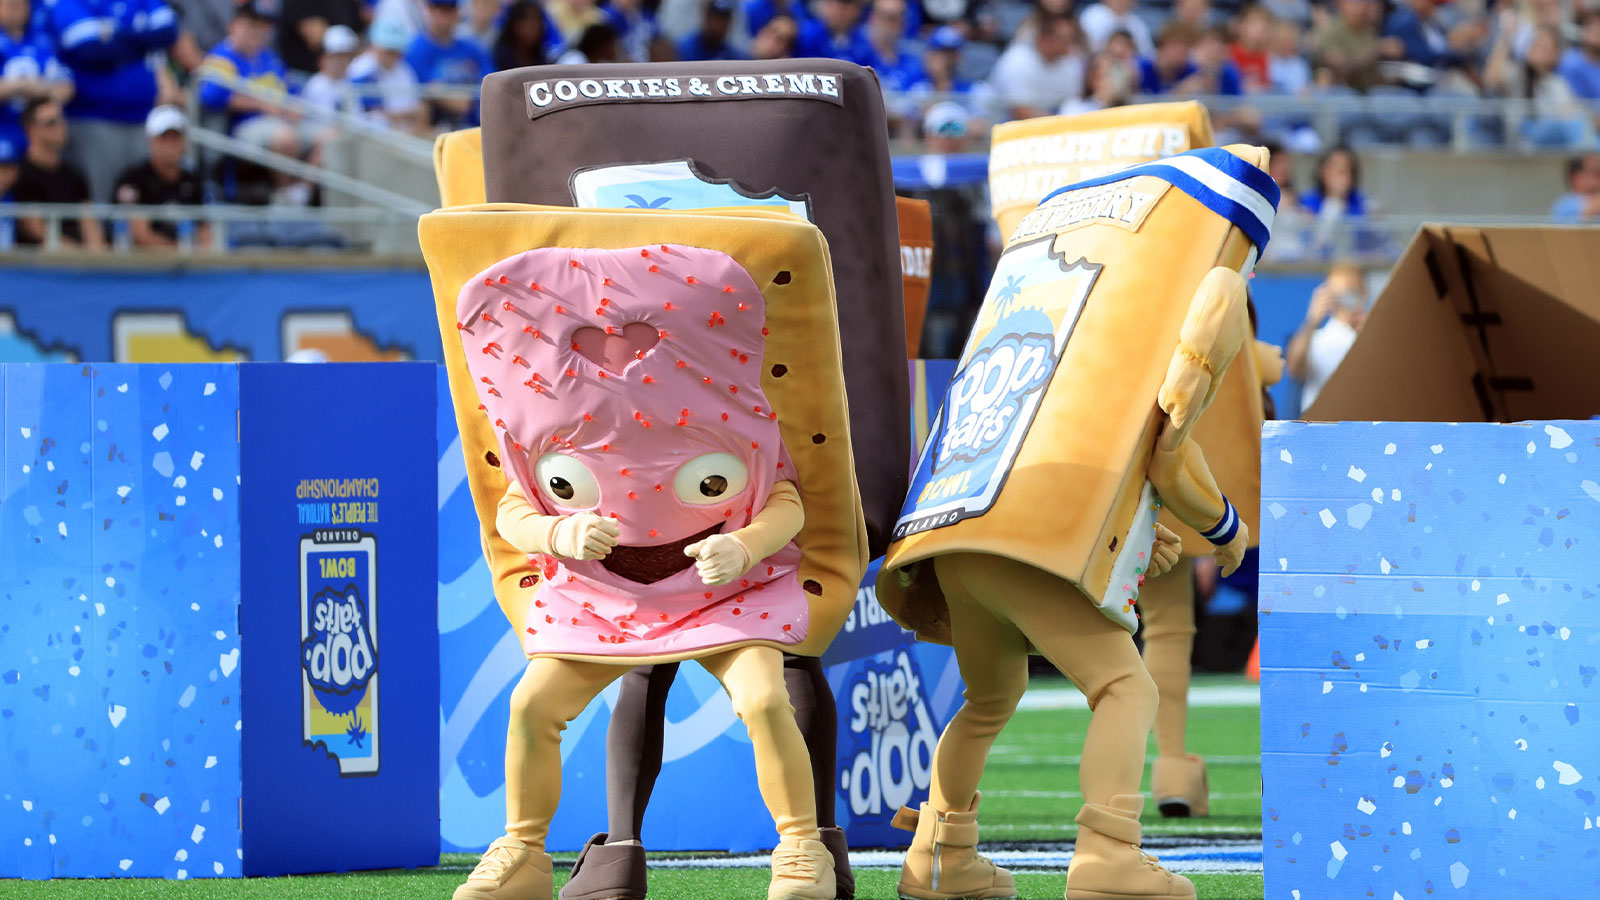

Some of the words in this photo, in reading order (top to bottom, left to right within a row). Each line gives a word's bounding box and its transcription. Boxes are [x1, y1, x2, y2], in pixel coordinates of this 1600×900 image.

[529, 79, 682, 107] COOKIES
[688, 77, 712, 96] &
[716, 74, 839, 97] CREME
[296, 478, 379, 499] CHAMPIONSHIP
[916, 471, 972, 504] BOWL
[297, 503, 330, 524] NATIONAL
[331, 502, 366, 524] PEOPLE'S
[367, 502, 379, 523] THE
[897, 512, 958, 537] ORLANDO
[316, 531, 359, 542] ORLANDO
[319, 557, 356, 578] BOWL
